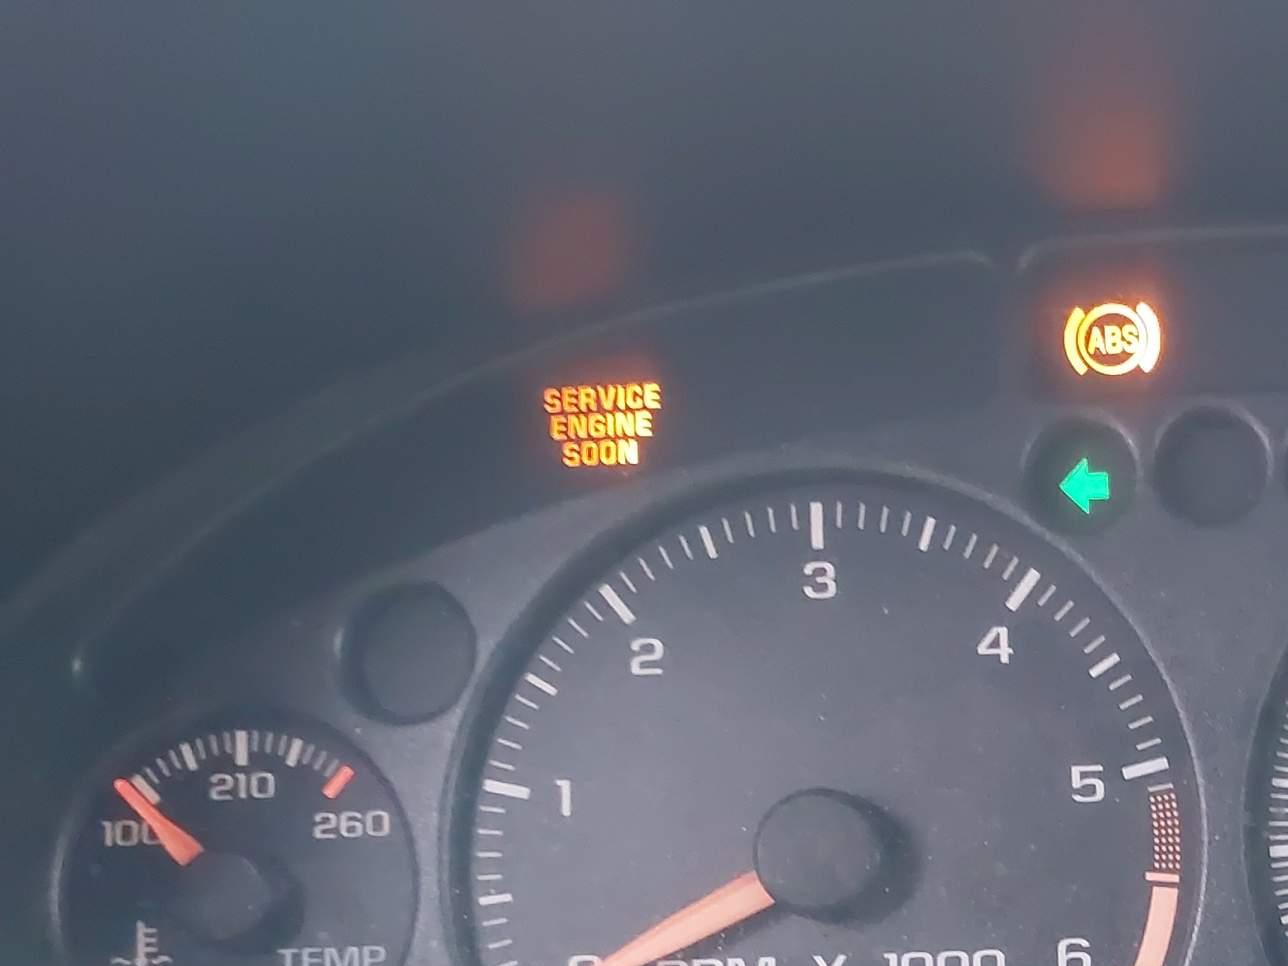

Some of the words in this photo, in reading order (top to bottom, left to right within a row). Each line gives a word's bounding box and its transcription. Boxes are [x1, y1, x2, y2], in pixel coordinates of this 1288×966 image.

[1087, 324, 1138, 355] ABS
[543, 382, 662, 414] SERVICE
[550, 411, 653, 440] ENGINE
[562, 438, 639, 467] SOON
[802, 562, 838, 599] 3
[629, 638, 665, 676] 2
[977, 625, 1013, 664] 4
[208, 772, 276, 801] 210
[554, 779, 571, 816] 1
[1070, 764, 1105, 803] 5
[312, 810, 391, 838] 260
